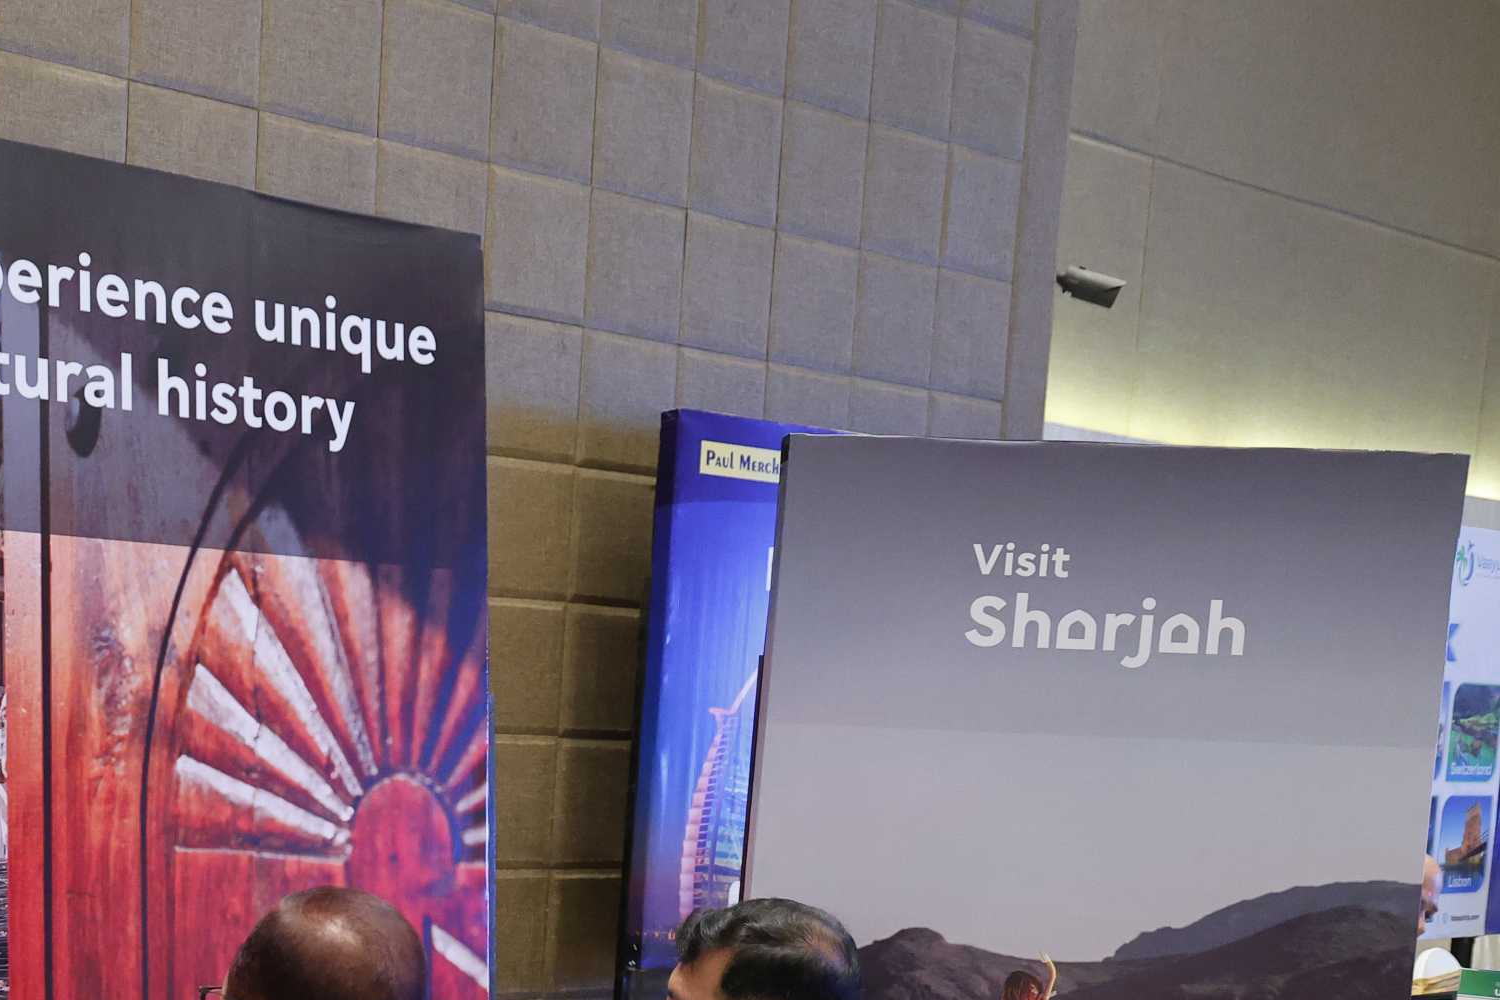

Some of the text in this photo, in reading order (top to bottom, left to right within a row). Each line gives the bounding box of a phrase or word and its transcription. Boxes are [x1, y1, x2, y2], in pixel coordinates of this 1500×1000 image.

[254, 295, 437, 374] unique
[157, 358, 355, 452] history
[973, 542, 1070, 578] Visit
[964, 592, 1245, 668] Sharjah
